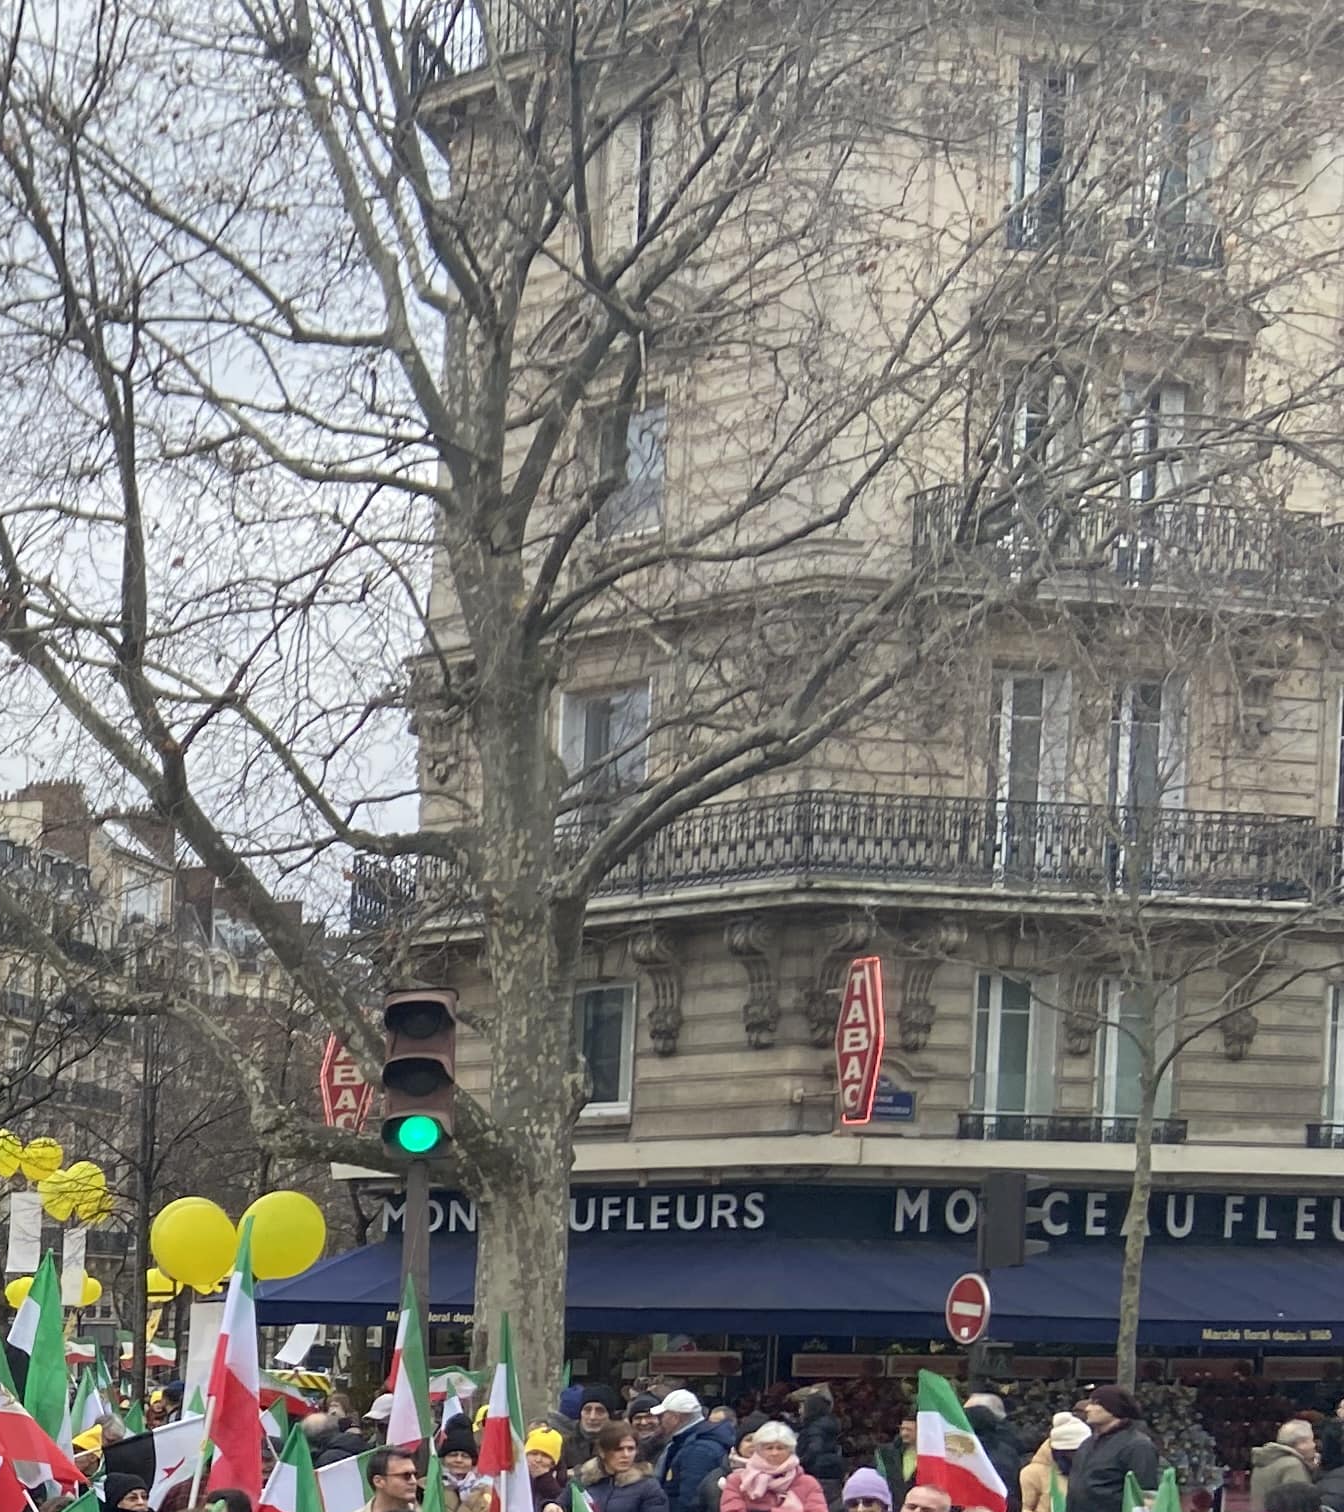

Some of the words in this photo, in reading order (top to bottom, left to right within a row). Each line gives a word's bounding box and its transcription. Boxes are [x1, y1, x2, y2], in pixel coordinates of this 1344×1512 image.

[842, 971, 869, 1107] TABAC
[332, 1046, 365, 1130] ABAC
[894, 1188, 1194, 1239] MOCEAU
[1202, 1328, 1240, 1340] Marché
